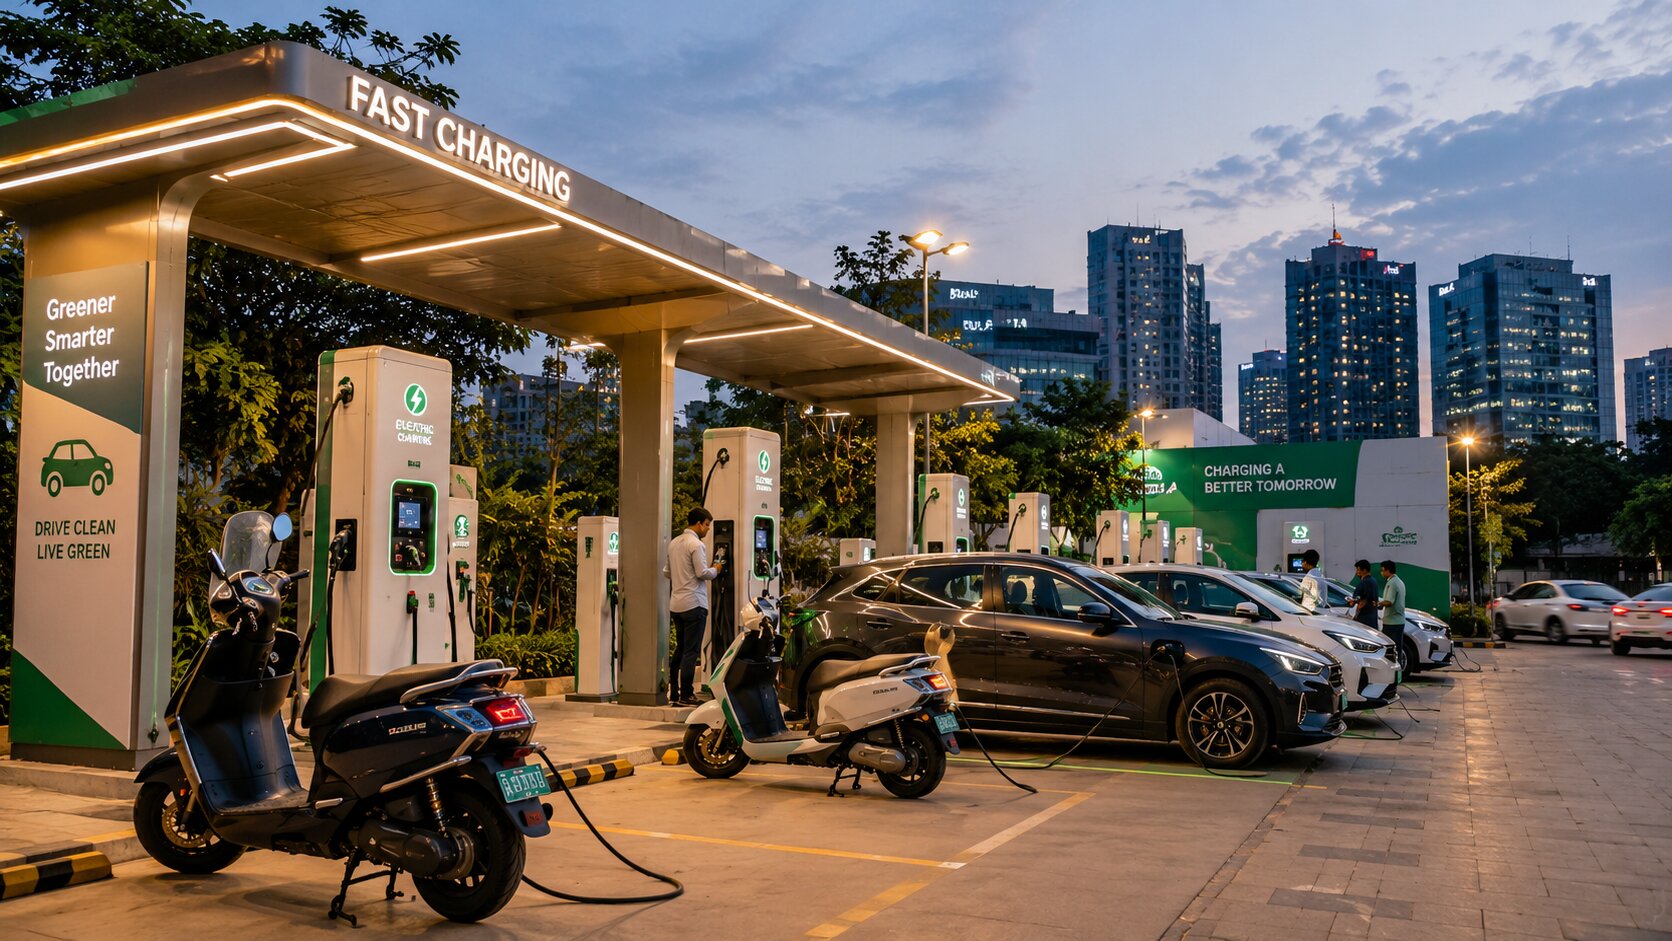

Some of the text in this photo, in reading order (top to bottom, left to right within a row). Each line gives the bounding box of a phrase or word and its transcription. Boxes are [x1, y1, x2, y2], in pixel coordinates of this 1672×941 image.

[349, 75, 571, 202] FAST CHARGING
[46, 295, 117, 320] Greener
[45, 325, 115, 351] Smarter
[43, 356, 120, 387] Together
[1204, 463, 1285, 478] CHARGING A
[1204, 478, 1337, 493] BETTER TOMORROW
[35, 519, 116, 536] DRIVE CLEAN
[37, 543, 110, 559] LIVE GREEN
